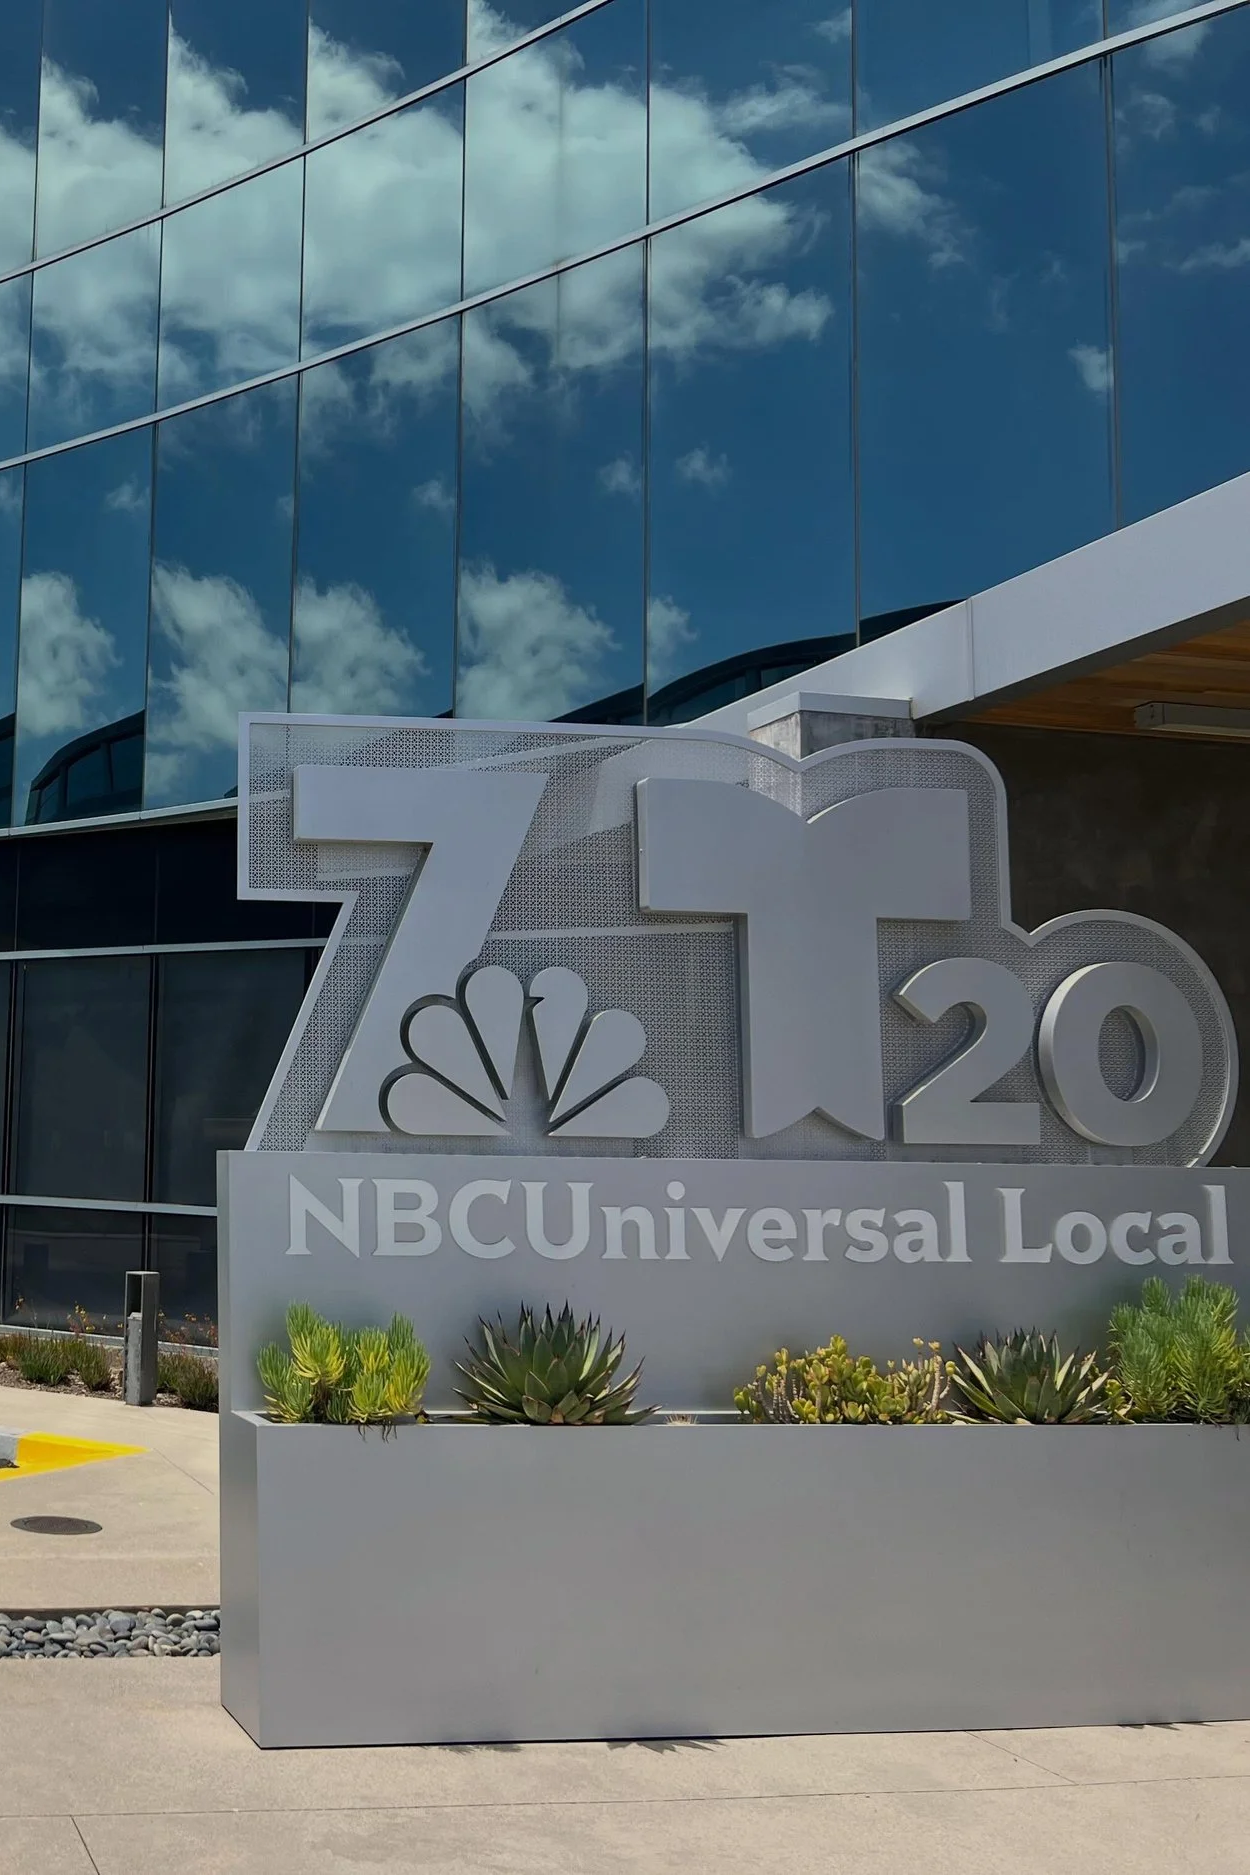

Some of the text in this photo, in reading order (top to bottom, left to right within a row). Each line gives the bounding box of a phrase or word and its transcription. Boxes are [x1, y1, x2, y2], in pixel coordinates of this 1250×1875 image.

[293, 766, 547, 1132] 7
[286, 1174, 1232, 1267] NBCUniversal Local
